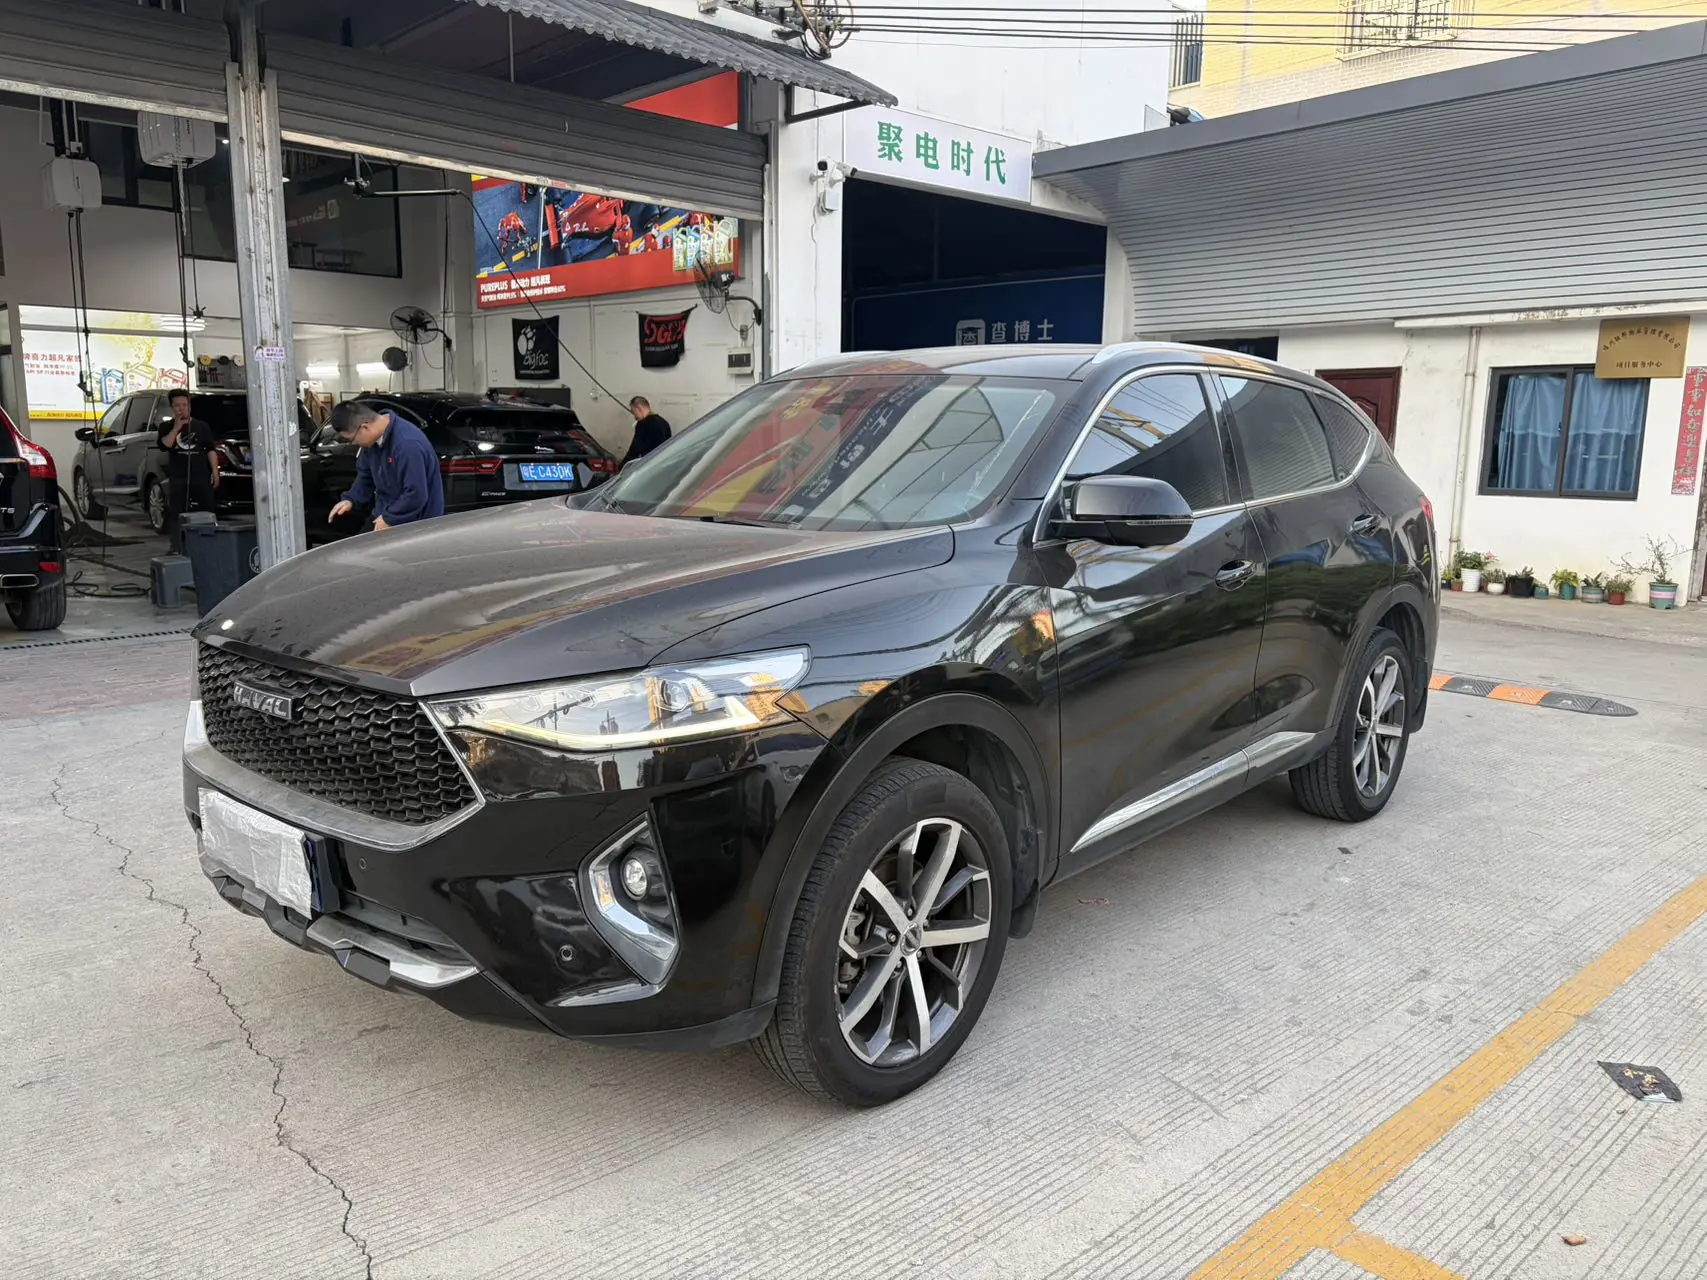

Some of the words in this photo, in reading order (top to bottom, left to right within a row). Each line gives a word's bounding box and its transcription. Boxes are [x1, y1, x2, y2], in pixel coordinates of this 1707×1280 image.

[877, 121, 1007, 185] 聚电时代
[991, 318, 1054, 343] 查博士
[233, 685, 287, 717] HAVAL
